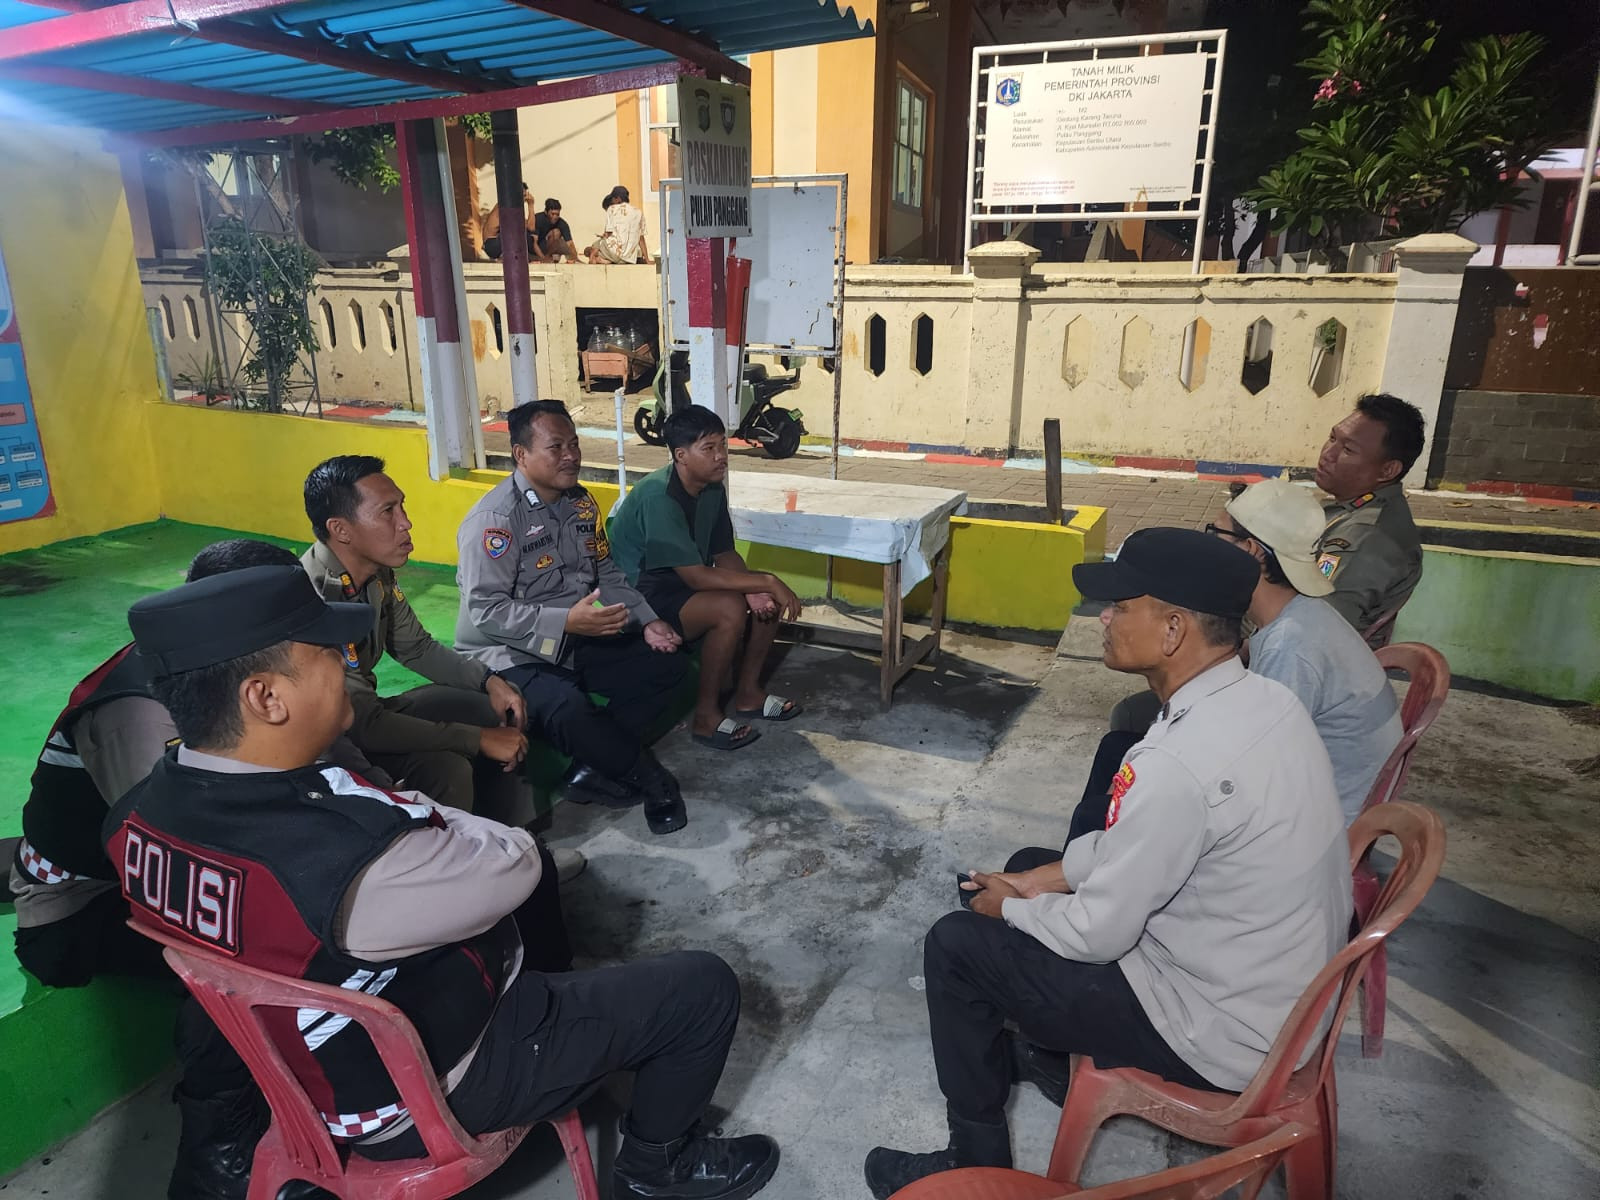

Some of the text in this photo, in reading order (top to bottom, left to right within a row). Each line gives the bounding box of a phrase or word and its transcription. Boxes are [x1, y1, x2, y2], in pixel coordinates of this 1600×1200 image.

[1072, 64, 1135, 77] TANAH MILIK
[1044, 75, 1161, 91] PEMERINTAH PROVINSI
[1069, 90, 1133, 102] DKI JAKARTA
[687, 141, 748, 187] POSKAMLING
[690, 195, 748, 227] PULAU PANGGANG
[124, 829, 237, 947] POLISI
